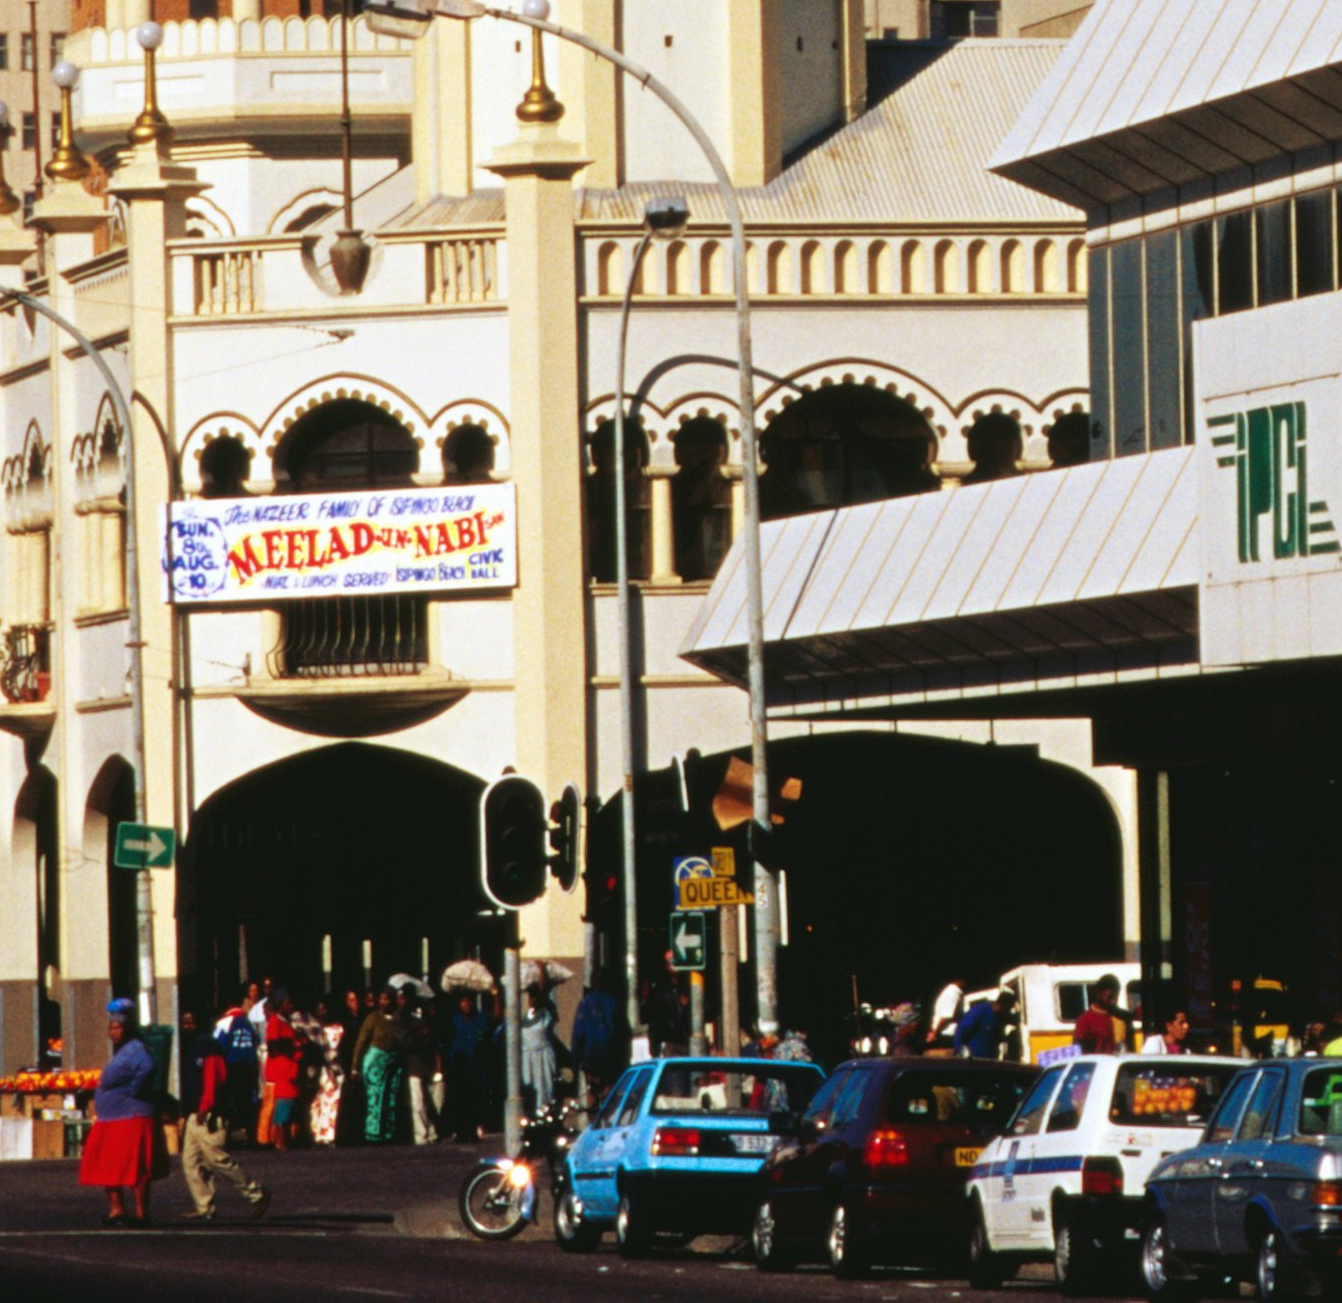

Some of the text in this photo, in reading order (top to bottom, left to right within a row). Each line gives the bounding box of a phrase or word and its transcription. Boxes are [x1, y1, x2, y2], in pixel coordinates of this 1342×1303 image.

[253, 502, 310, 521] NAZEER
[367, 497, 385, 517] OF
[344, 571, 389, 588] SERVED
